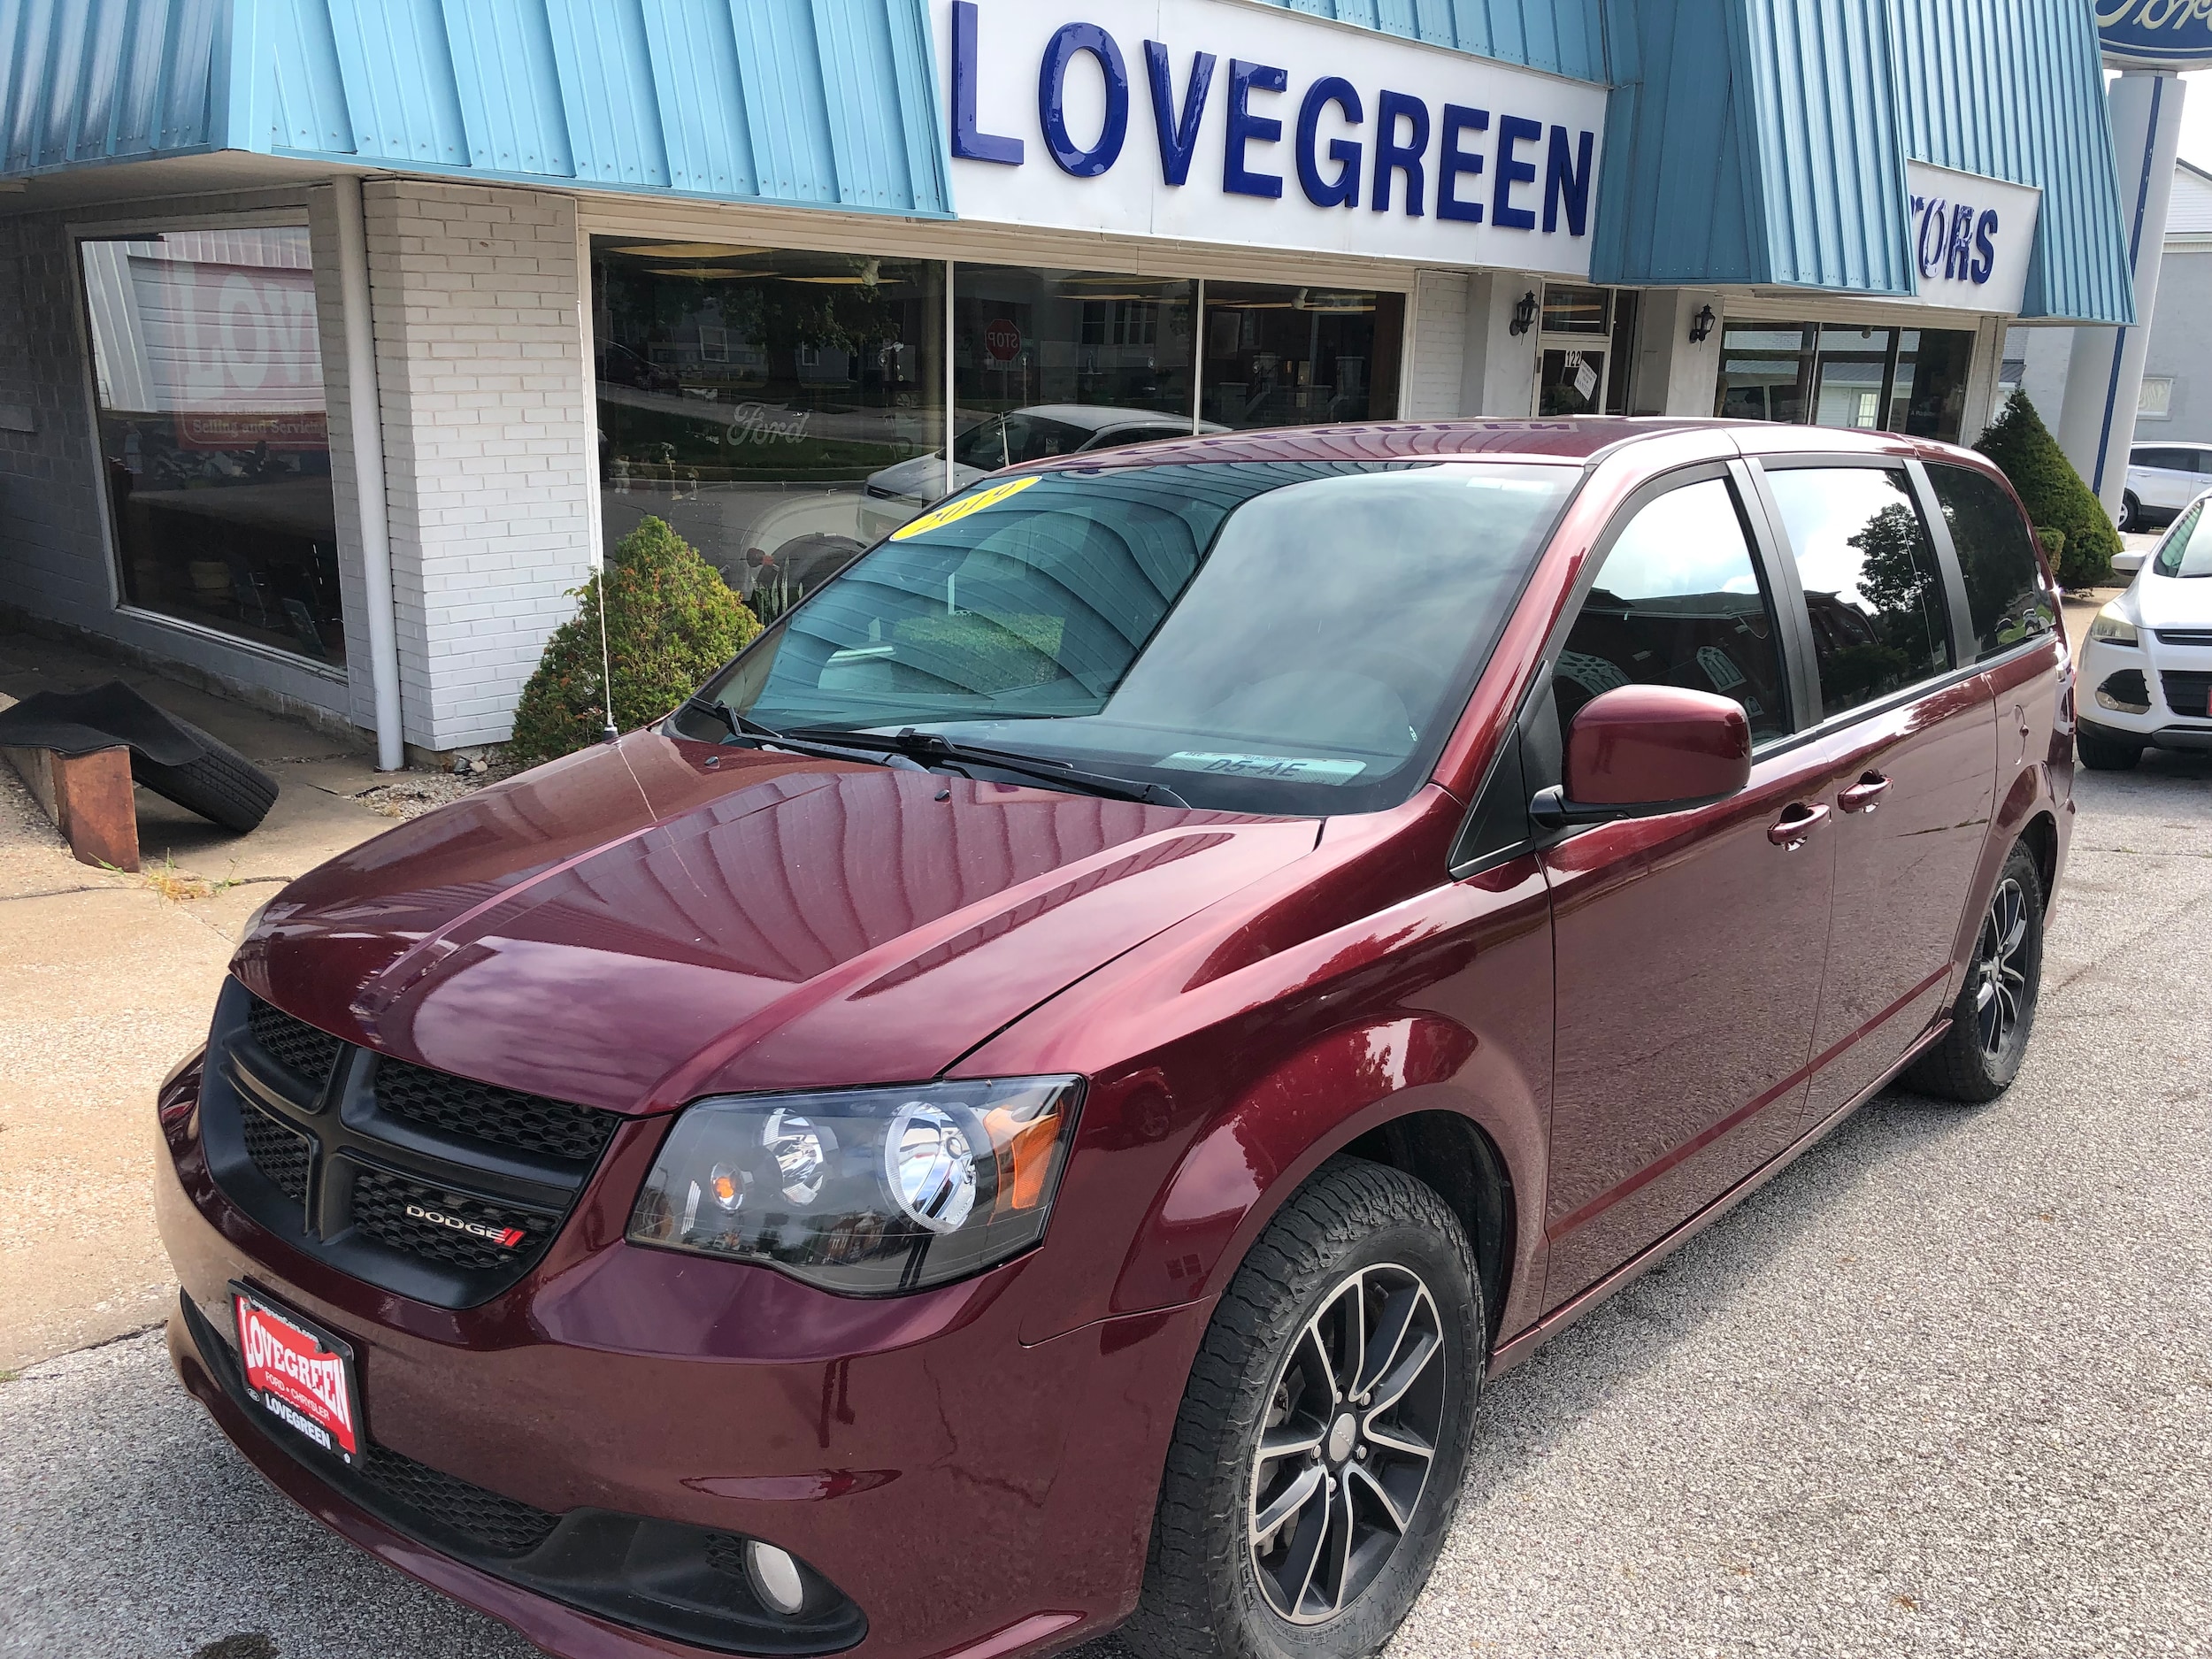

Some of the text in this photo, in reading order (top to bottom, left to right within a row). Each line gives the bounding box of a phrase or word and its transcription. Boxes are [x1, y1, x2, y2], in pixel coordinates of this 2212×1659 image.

[951, 1, 1594, 236] LOVEGREEN
[1567, 350, 1581, 367] 122
[192, 419, 327, 438] Selling and Servicing
[726, 401, 813, 446] Ford
[913, 482, 1018, 534] 2019
[406, 1204, 506, 1242] DODGE
[239, 1296, 350, 1434] LOVEGREEN
[265, 1371, 285, 1394] FORD
[290, 1387, 331, 1422] CHRYSLER
[265, 1392, 332, 1451] LOVEGREEN
